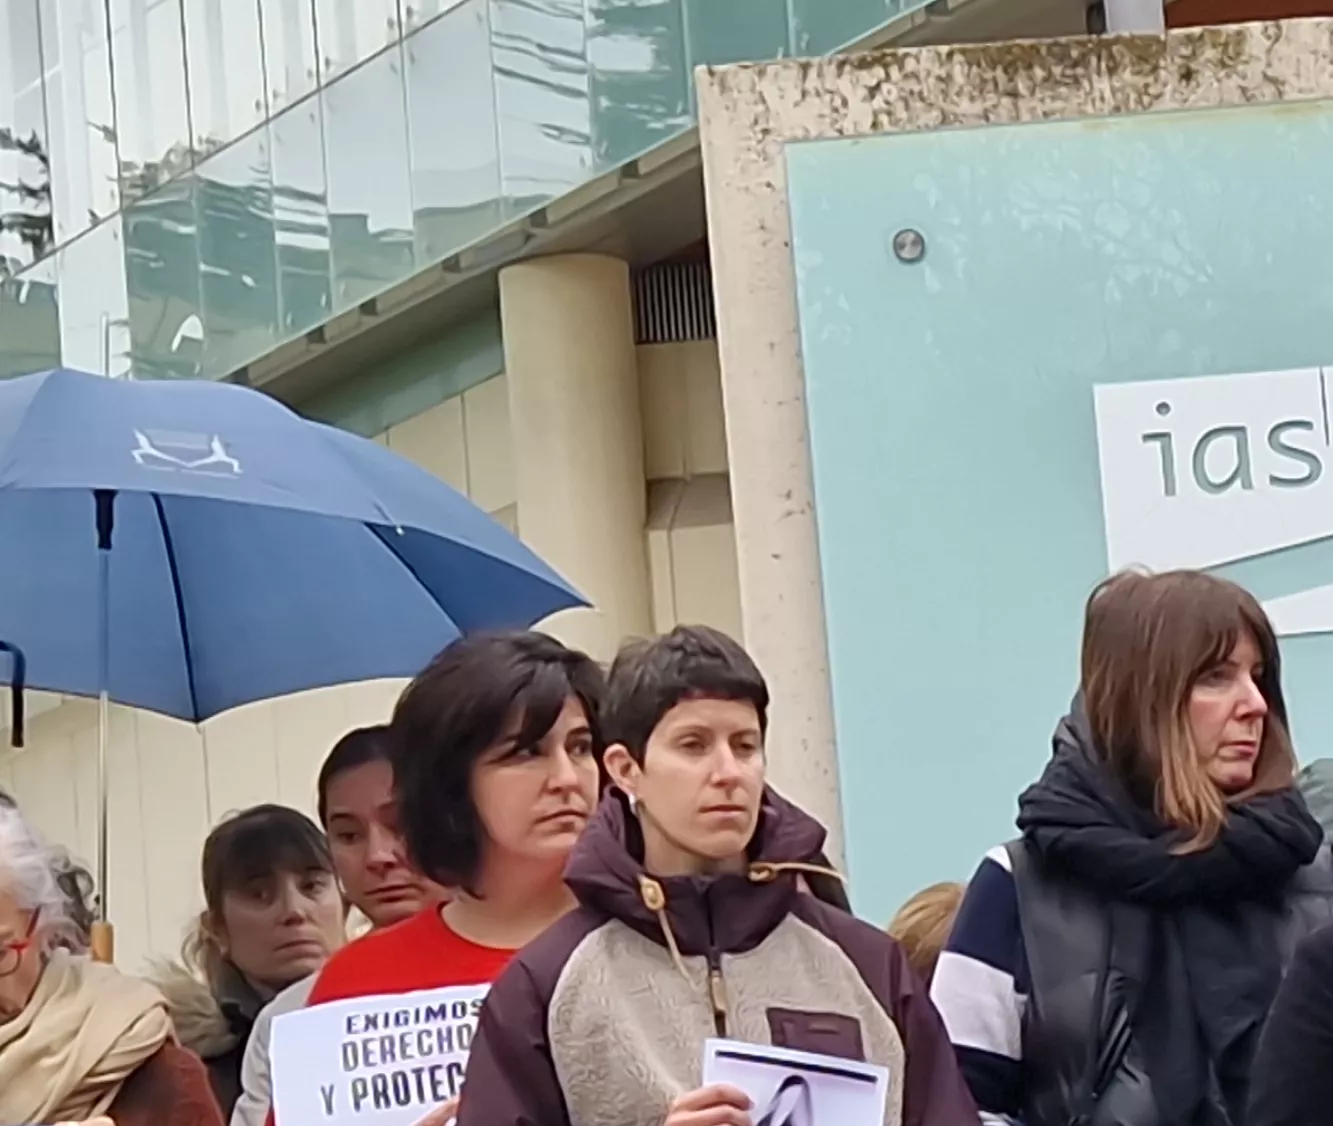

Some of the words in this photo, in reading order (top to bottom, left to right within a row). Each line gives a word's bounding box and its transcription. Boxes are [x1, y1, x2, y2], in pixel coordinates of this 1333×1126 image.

[346, 999, 485, 1035] EXIGIMOS
[341, 1023, 473, 1072] DERECHO
[320, 1083, 335, 1116] Y
[351, 1062, 465, 1113] PROTEC
